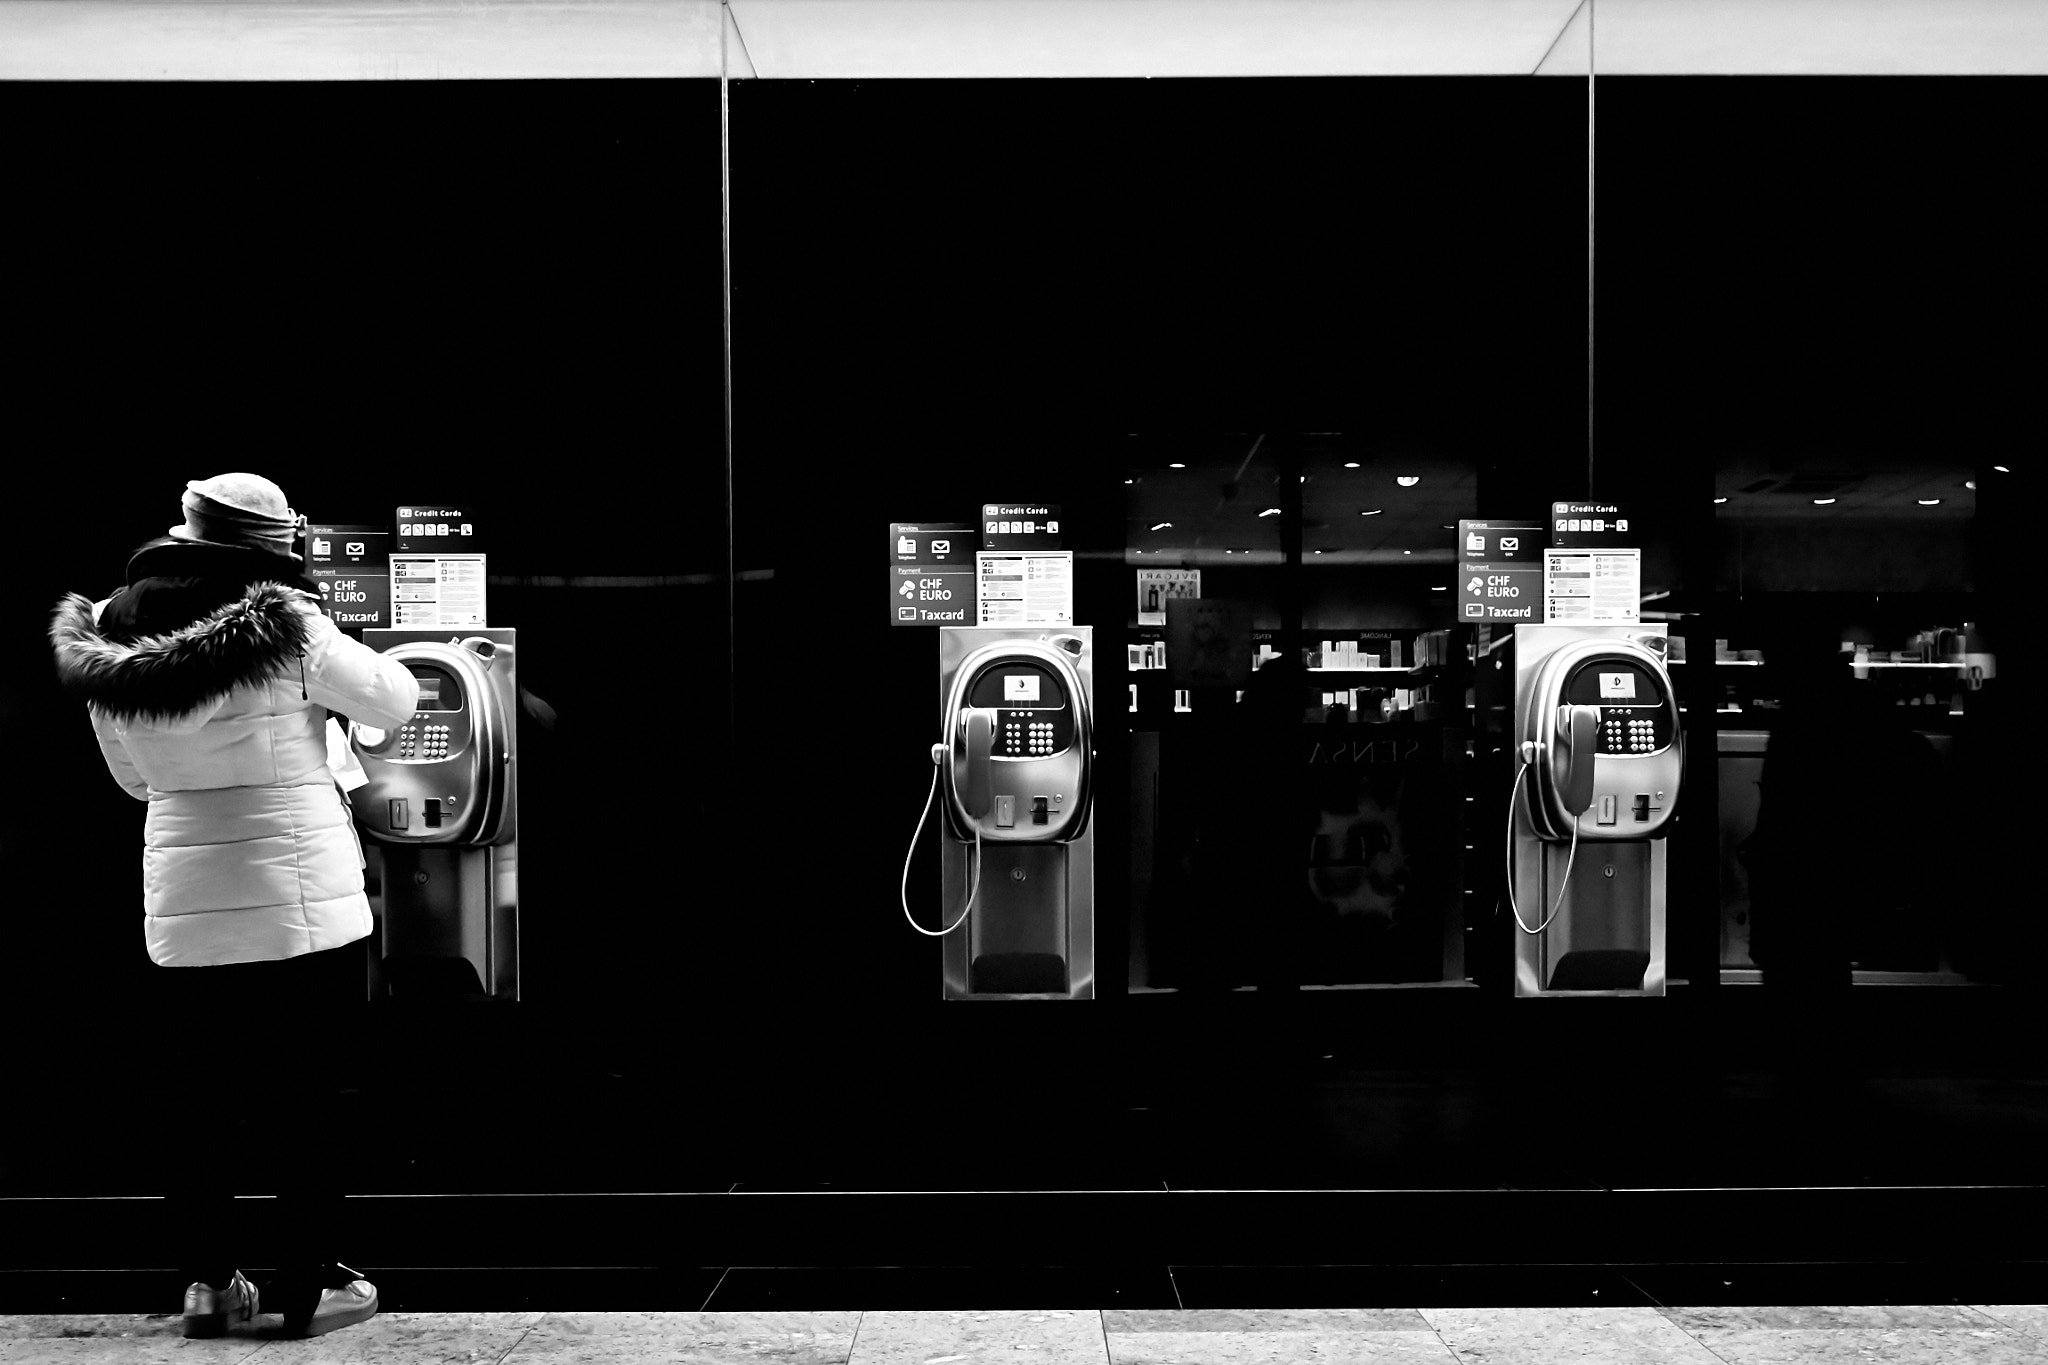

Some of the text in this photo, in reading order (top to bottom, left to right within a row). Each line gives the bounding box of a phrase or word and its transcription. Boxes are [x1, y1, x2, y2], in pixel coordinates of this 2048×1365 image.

[414, 509, 462, 517] Credit Cards
[1000, 507, 1048, 515] Credit Cards
[1570, 505, 1618, 513] Credit Cards
[898, 567, 921, 575] Payment
[334, 580, 357, 591] CHF
[919, 578, 943, 589] CHF
[1487, 575, 1510, 586] CHF
[334, 591, 367, 602] EURO
[919, 590, 952, 600] EURO
[1487, 587, 1520, 597] EURO
[334, 610, 379, 622] Taxcard
[920, 608, 964, 620] Taxcard
[1487, 605, 1531, 618] Taxcard
